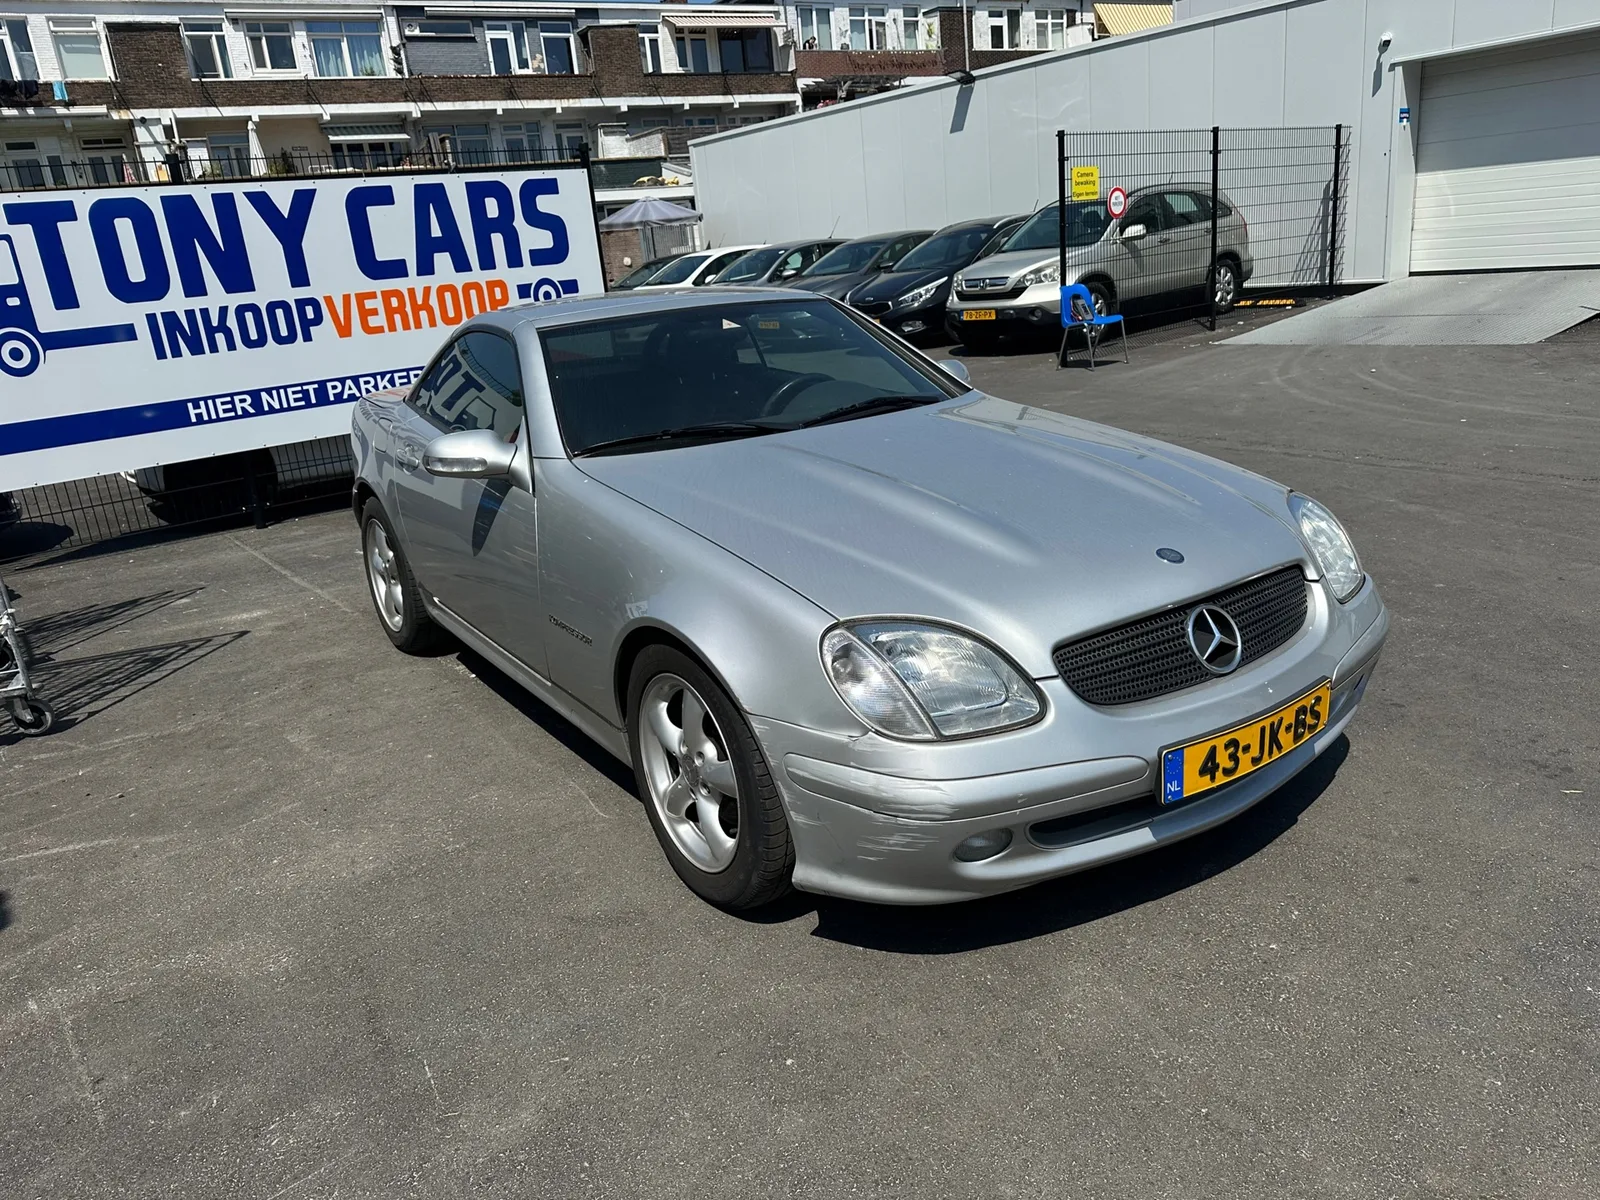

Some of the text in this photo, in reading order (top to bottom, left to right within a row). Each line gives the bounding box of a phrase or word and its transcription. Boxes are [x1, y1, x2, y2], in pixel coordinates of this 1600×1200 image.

[1074, 179, 1096, 187] bewaking
[3, 178, 570, 310] TONY CARS
[187, 394, 255, 423] HIER
[259, 384, 319, 411] NIET
[1198, 695, 1322, 783] 43-JK-BS
[1166, 780, 1181, 794] NL
